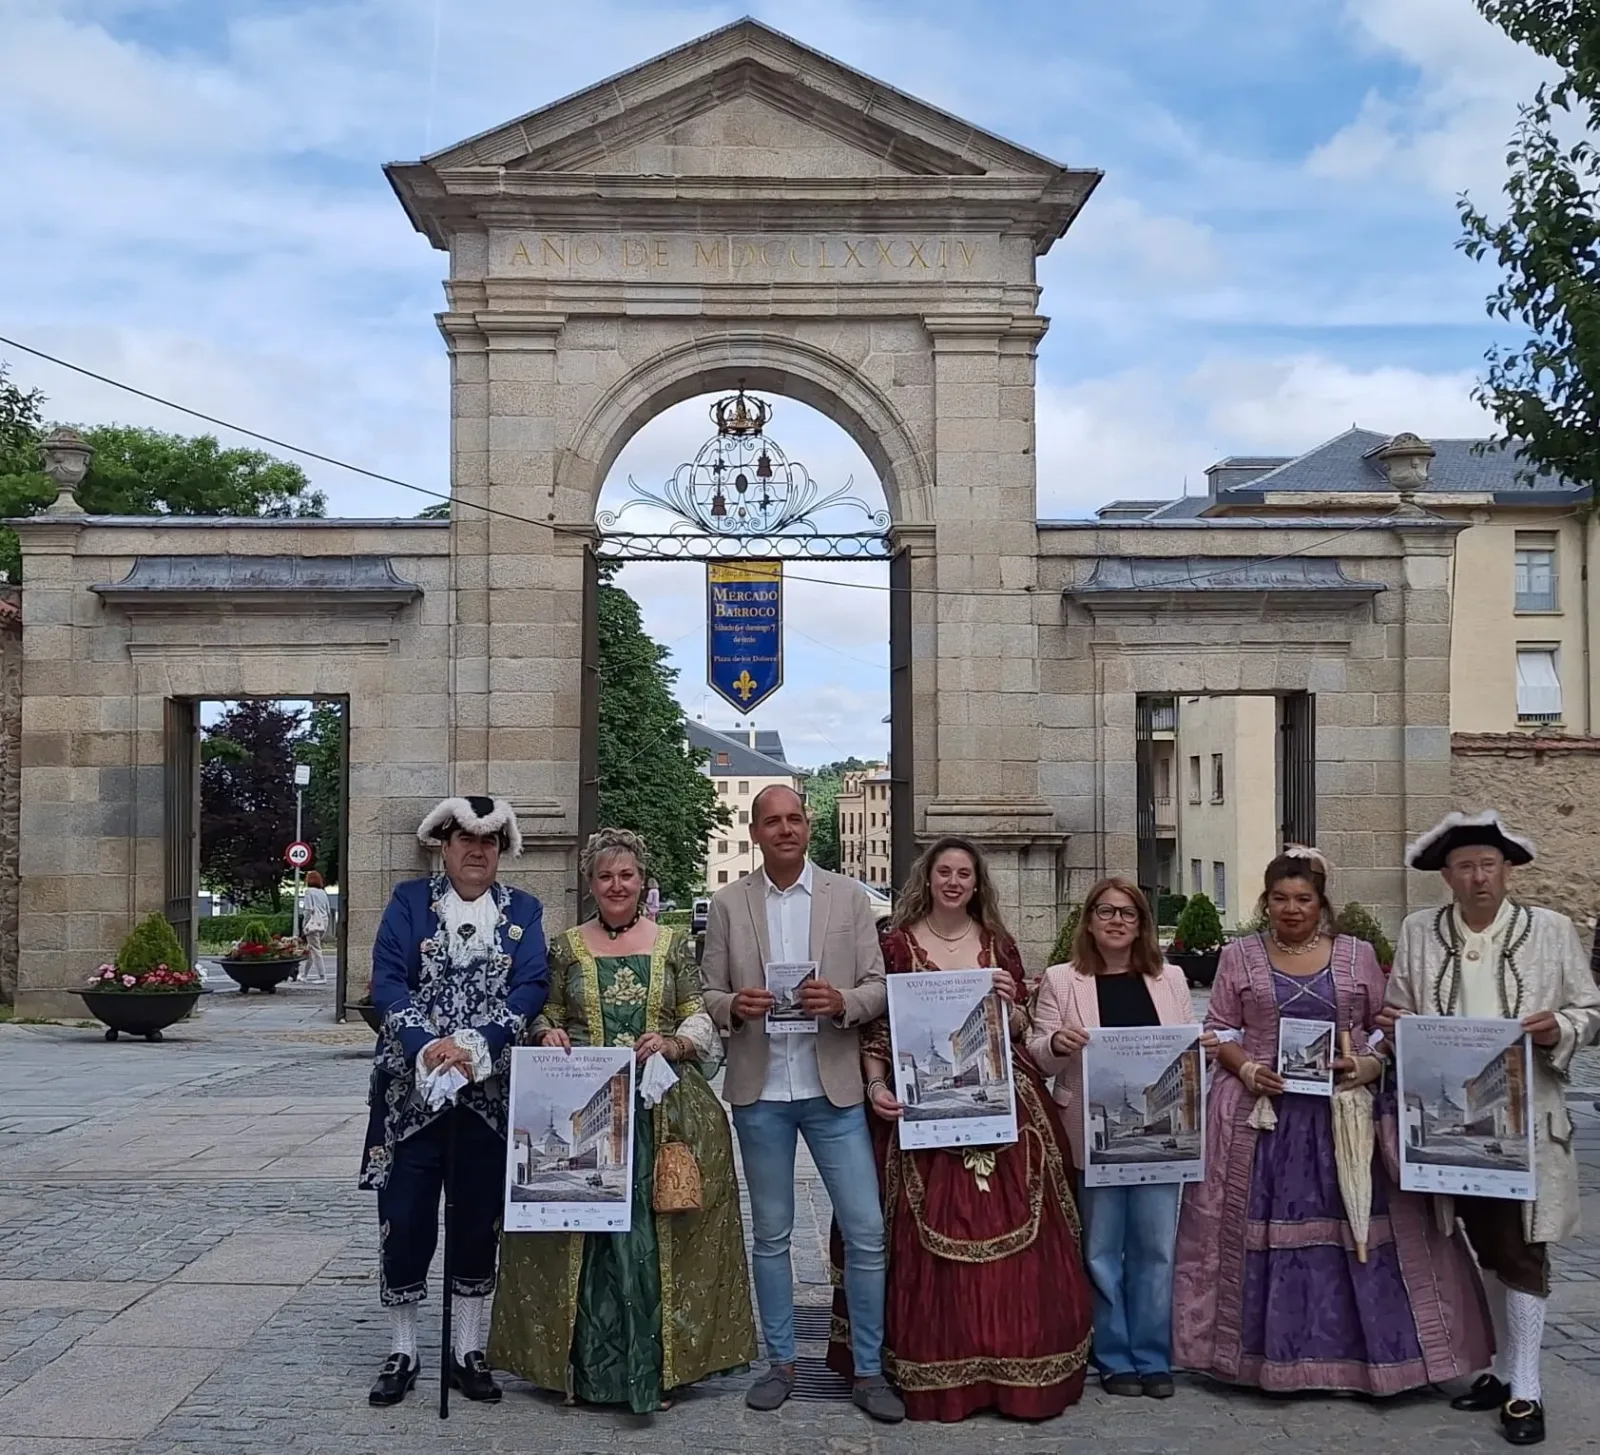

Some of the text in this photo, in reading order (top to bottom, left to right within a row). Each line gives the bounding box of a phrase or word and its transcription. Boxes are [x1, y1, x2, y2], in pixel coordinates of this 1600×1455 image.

[623, 239, 669, 268] DE
[692, 238, 982, 269] MDCCLXXXIV
[713, 587, 778, 601] MERCADO
[714, 603, 776, 617] BARROCO
[291, 850, 306, 858] 40
